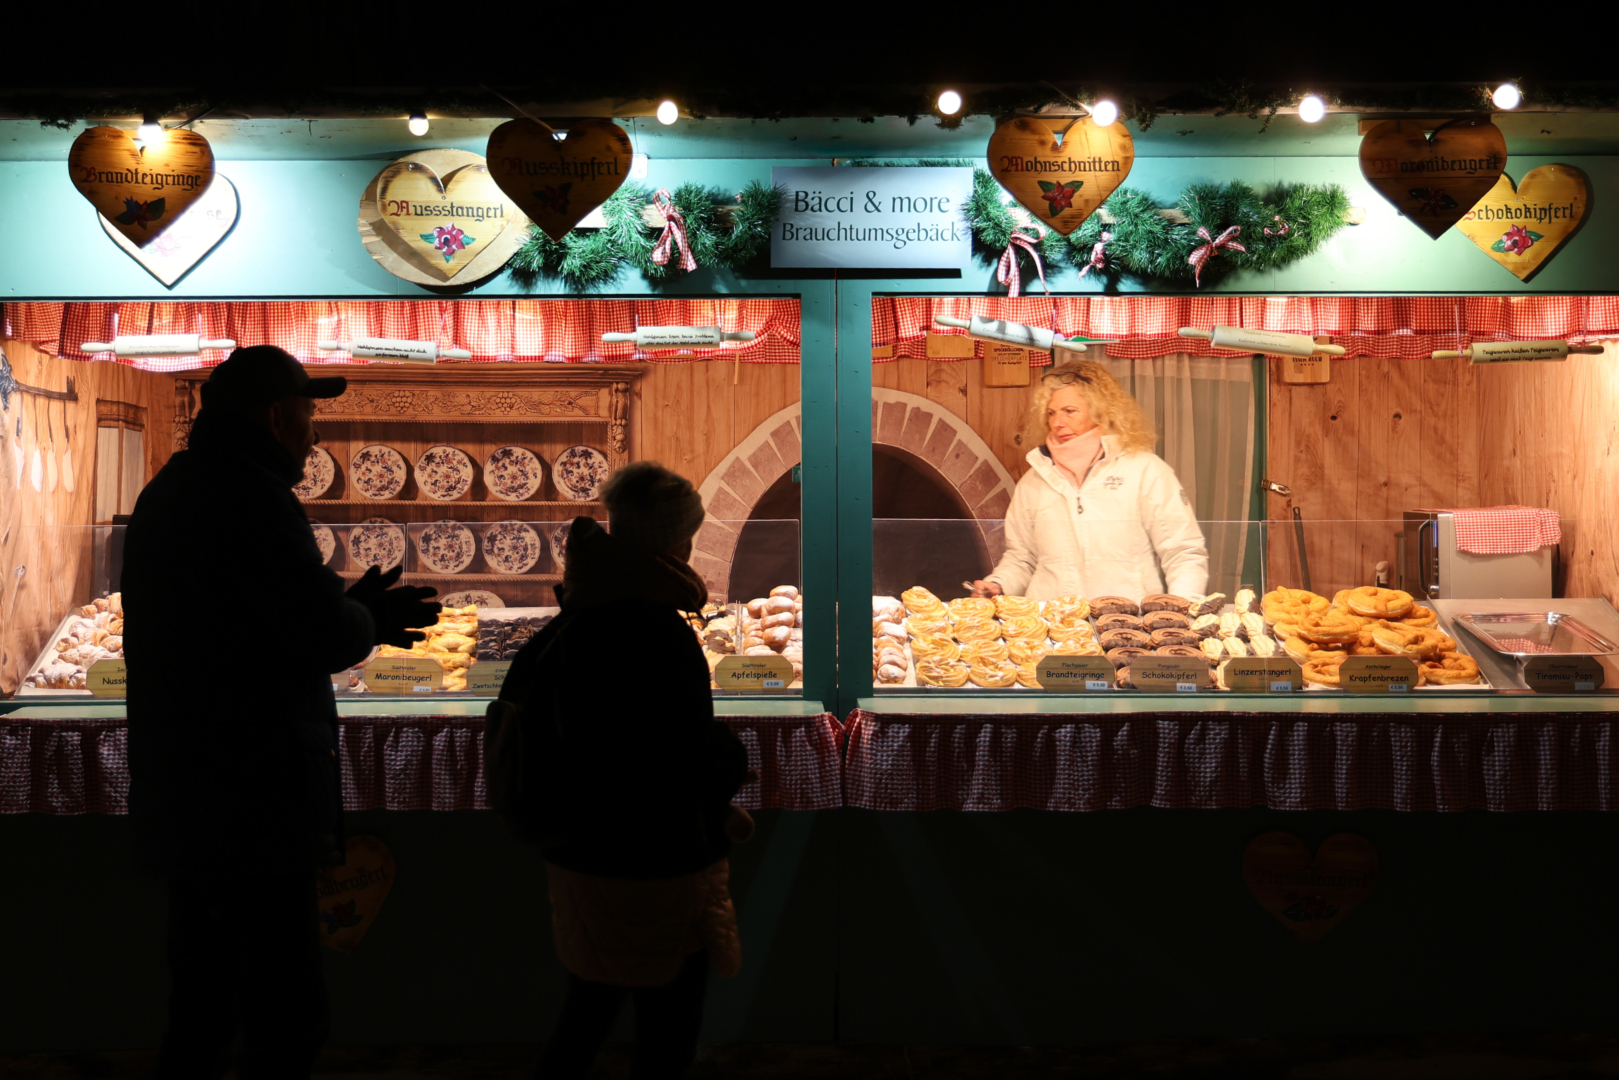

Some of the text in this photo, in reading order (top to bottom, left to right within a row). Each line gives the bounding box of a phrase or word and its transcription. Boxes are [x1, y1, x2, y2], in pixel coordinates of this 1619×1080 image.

[501, 156, 620, 181] Nusskipferl
[1000, 155, 1121, 173] Mohnschnitten
[1372, 153, 1500, 175] Maronibeugerl
[80, 167, 202, 191] Brandteigringe
[794, 190, 950, 214] Bäcci & more
[389, 199, 505, 219] Nussstangerl
[781, 221, 962, 249] Brauchtumsgebäck
[731, 671, 778, 680] Apfelspieße
[1046, 671, 1105, 680] Brandteigringe
[1142, 672, 1197, 680] Schokokipferl
[1233, 668, 1292, 677] Linzerstangerl
[1535, 672, 1594, 681] Tiramisu-Pops
[102, 677, 127, 685] Nussk
[375, 673, 432, 683] Maronibeugerl
[1349, 674, 1409, 683] Krapfenbrezen
